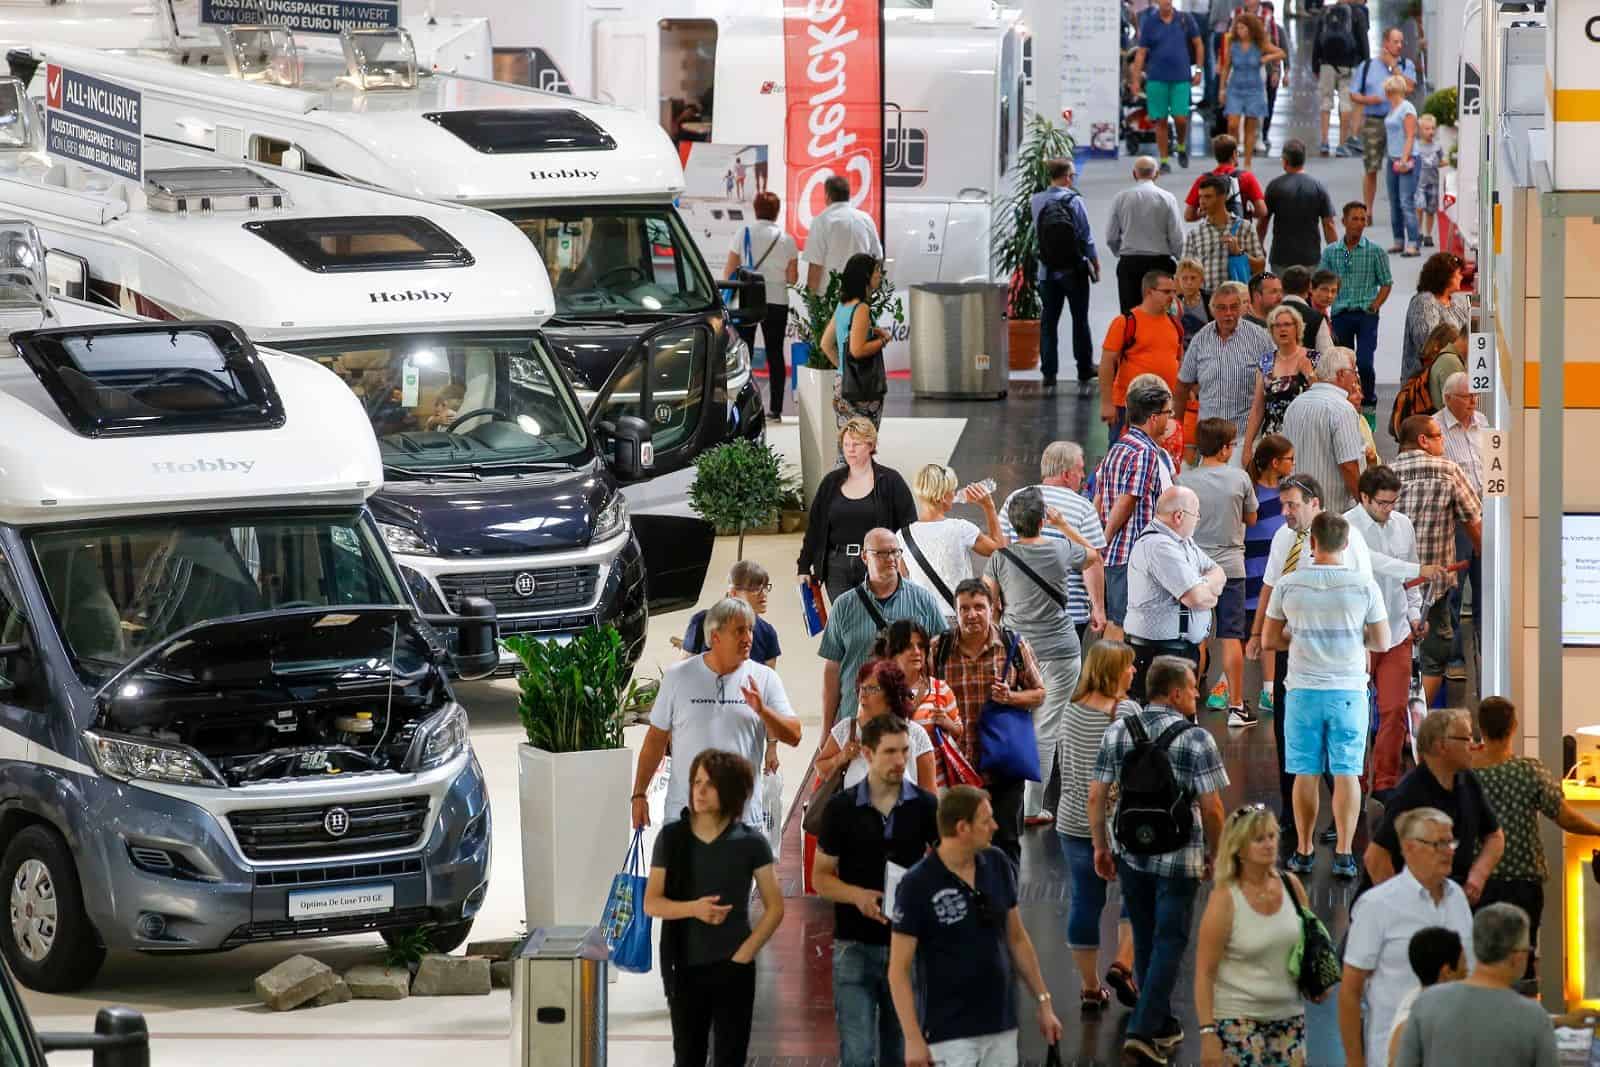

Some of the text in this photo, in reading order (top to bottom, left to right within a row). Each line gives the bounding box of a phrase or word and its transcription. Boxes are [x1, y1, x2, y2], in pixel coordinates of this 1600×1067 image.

[343, 7, 356, 17] IM
[359, 8, 390, 20] WERT
[302, 17, 331, 29] EURO
[51, 117, 114, 149] AUSSTATTUNGSPAKETE
[95, 148, 110, 166] EURO
[111, 153, 137, 176] INKLUSIVE
[530, 168, 600, 181] Hobby
[928, 231, 936, 240] A
[928, 243, 940, 252] 39
[369, 289, 453, 303] Hobby
[1477, 337, 1486, 350] 9
[1476, 358, 1487, 370] A
[1472, 377, 1489, 389] 32
[1492, 435, 1501, 449] 9
[152, 458, 256, 474] Hobby
[1491, 457, 1502, 471] A
[1487, 479, 1505, 493] 26
[300, 900, 328, 910] Optima
[329, 898, 339, 906] De
